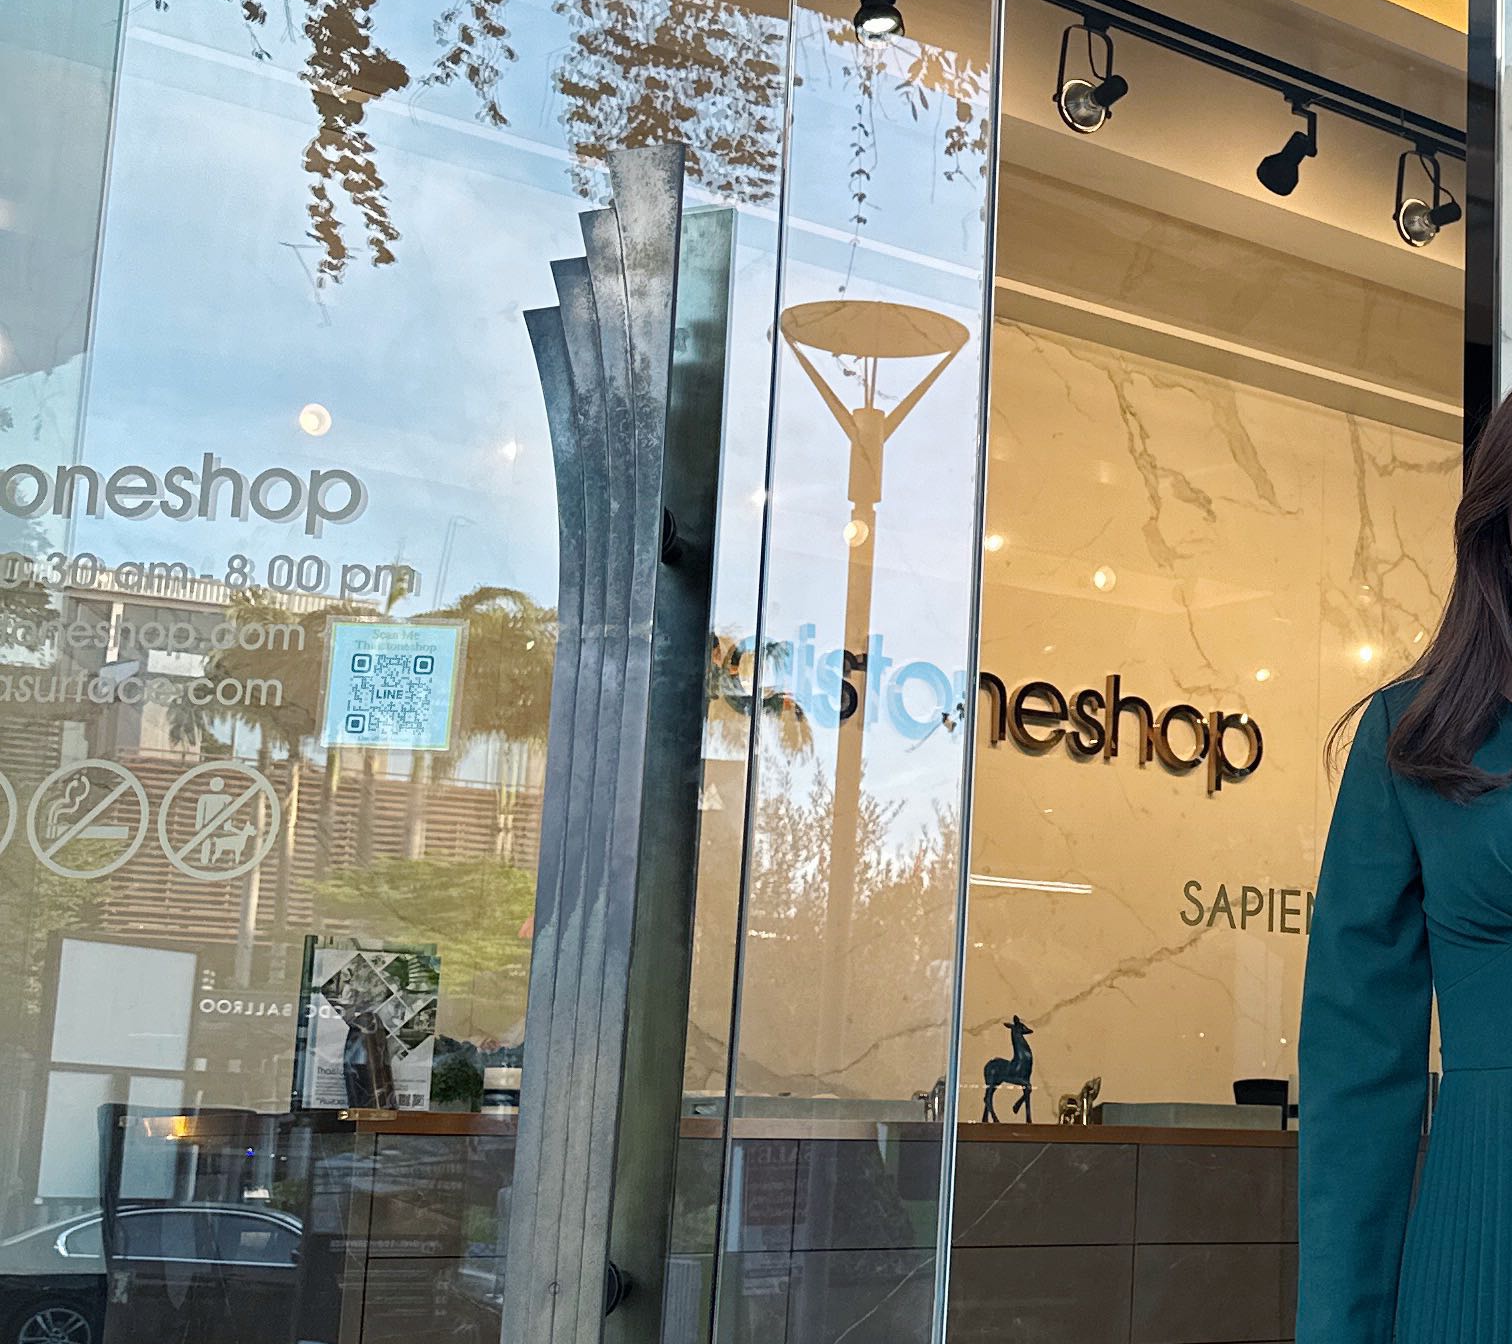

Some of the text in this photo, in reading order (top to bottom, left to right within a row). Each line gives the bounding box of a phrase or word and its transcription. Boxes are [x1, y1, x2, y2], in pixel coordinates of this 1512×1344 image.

[0, 452, 364, 536] oneshop
[115, 561, 187, 590] am
[225, 554, 324, 593] 8.00
[340, 563, 416, 599] pm
[375, 689, 404, 700] LINE
